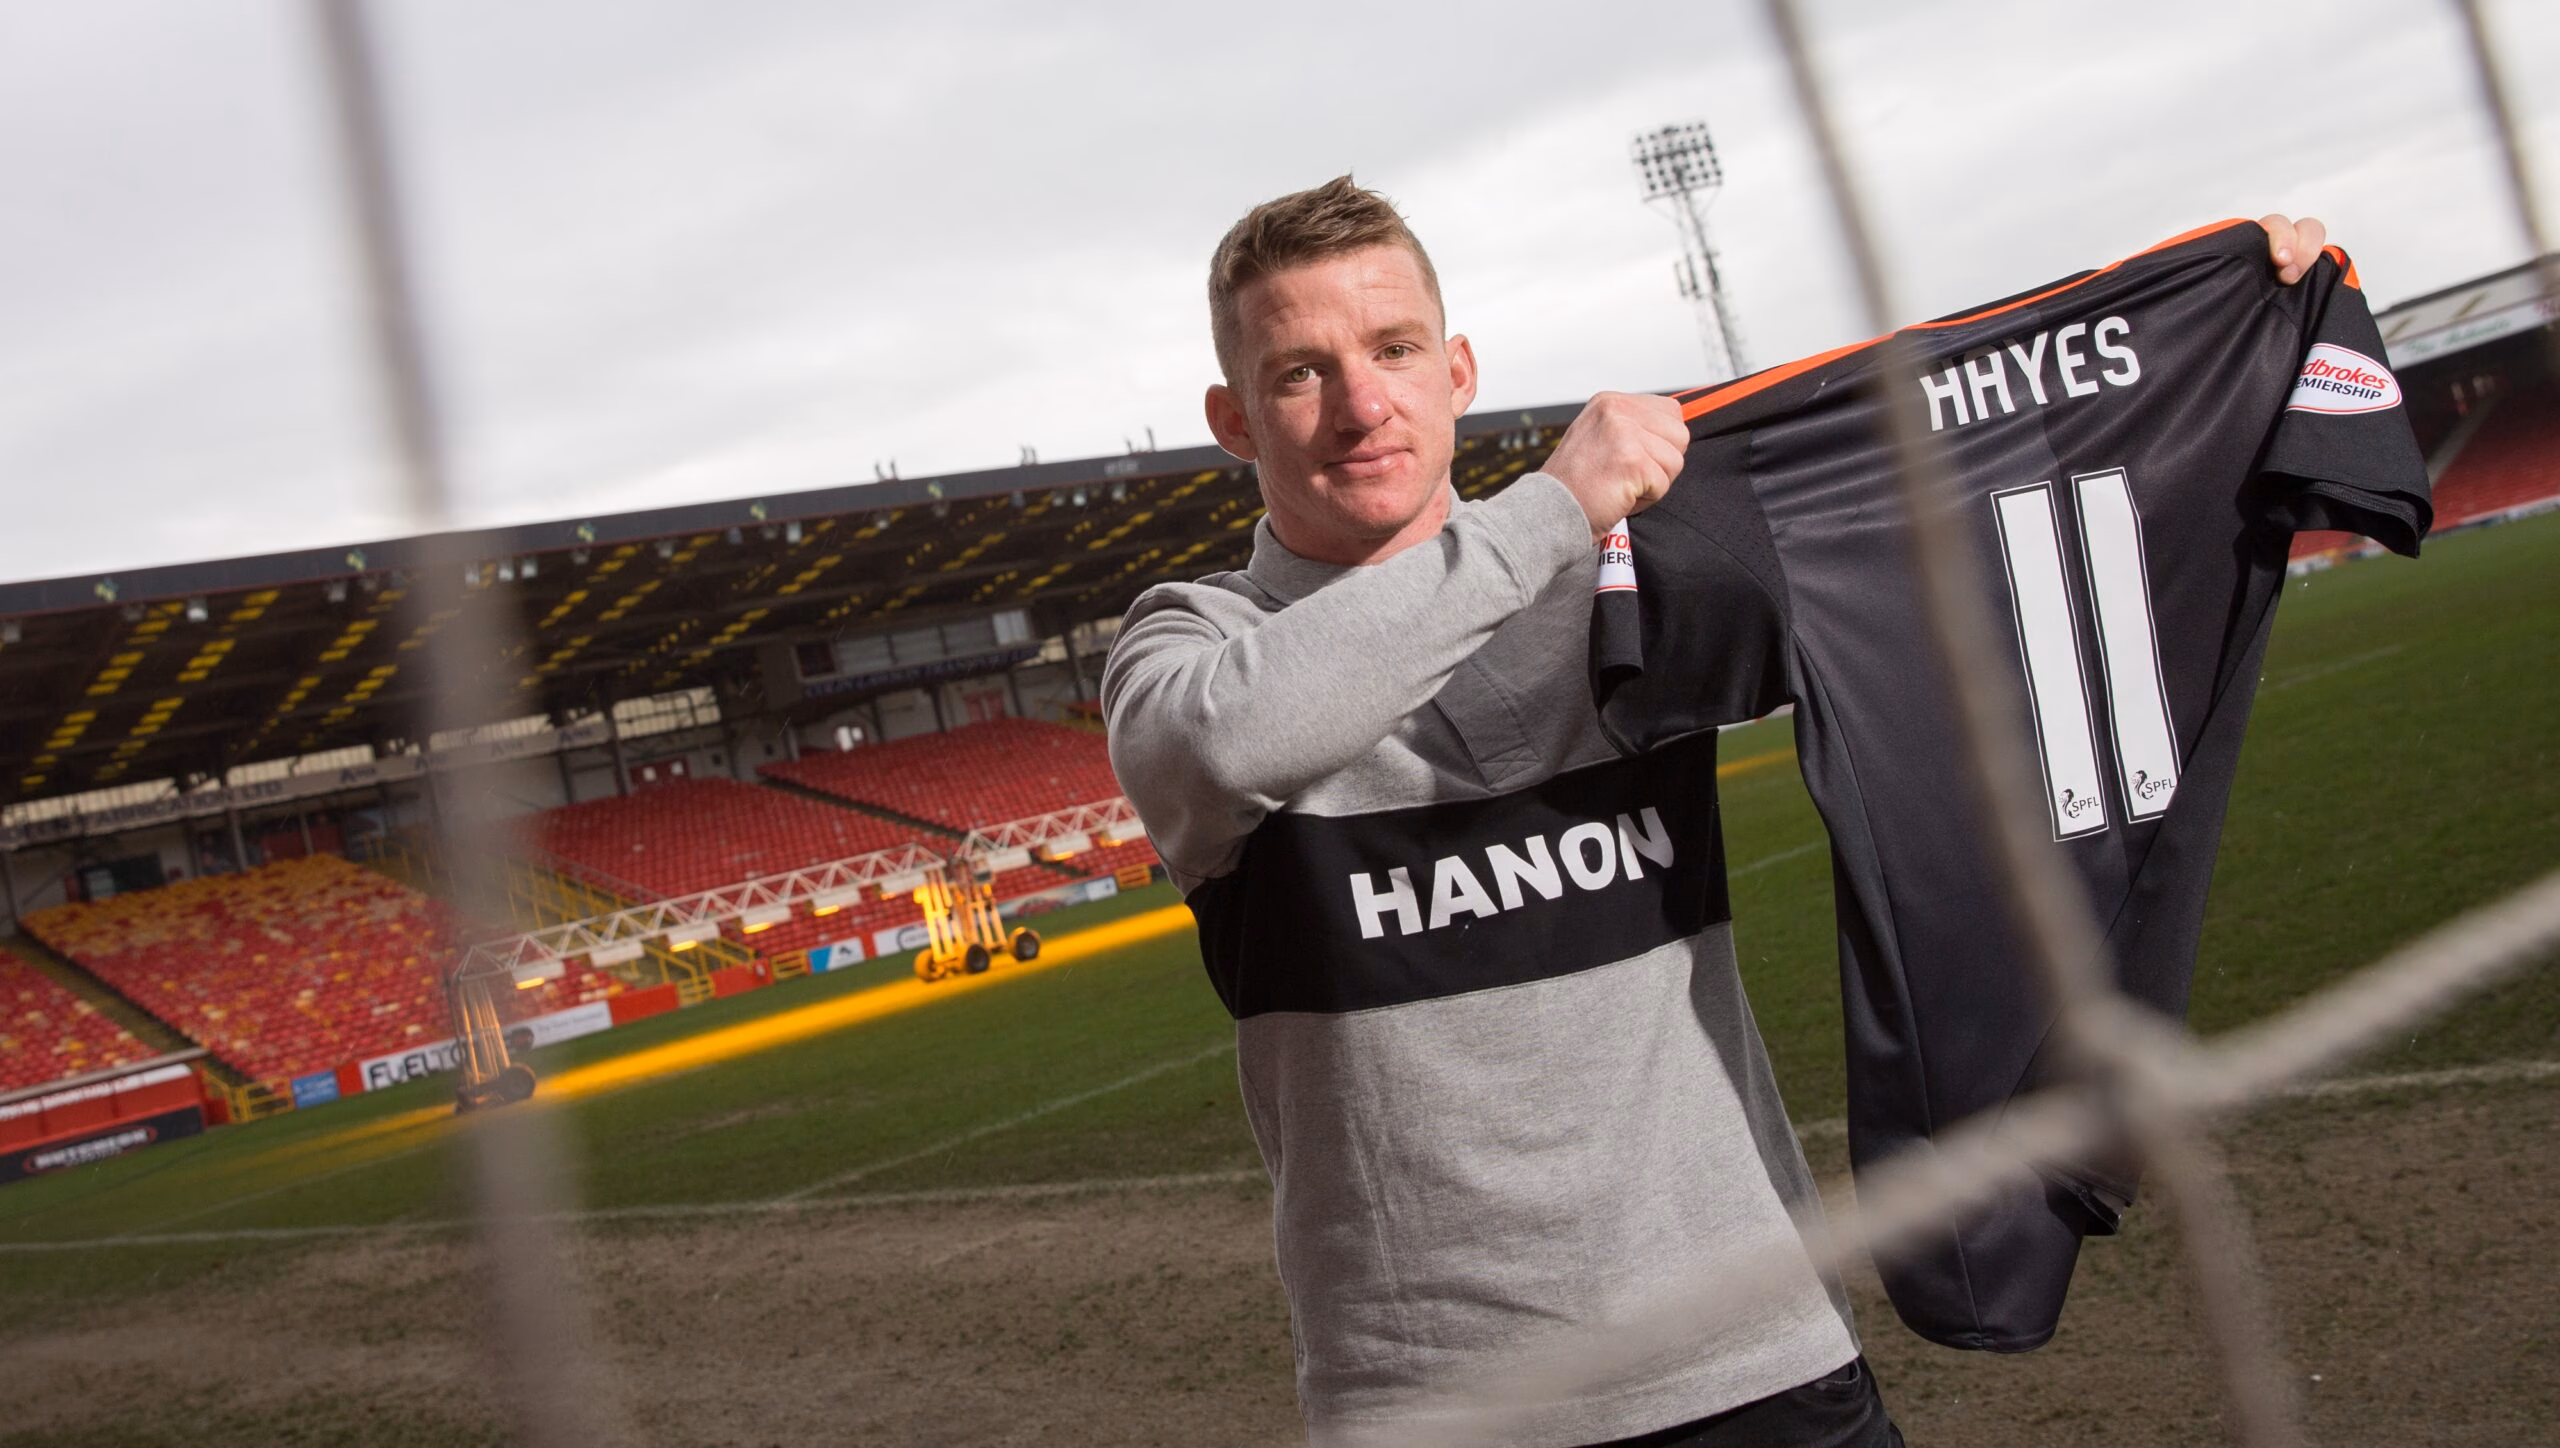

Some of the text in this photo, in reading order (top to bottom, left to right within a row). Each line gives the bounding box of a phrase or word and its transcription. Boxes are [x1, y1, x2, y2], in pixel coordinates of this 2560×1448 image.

[1918, 316, 2141, 431] HAYES
[2296, 377, 2382, 400] EMIERSHIP
[2301, 358, 2389, 390] dbrokes
[1991, 467, 2180, 842] 11
[2145, 778, 2175, 794] SPFL
[2072, 796, 2099, 812] SPFL
[1350, 806, 1674, 940] HANON
